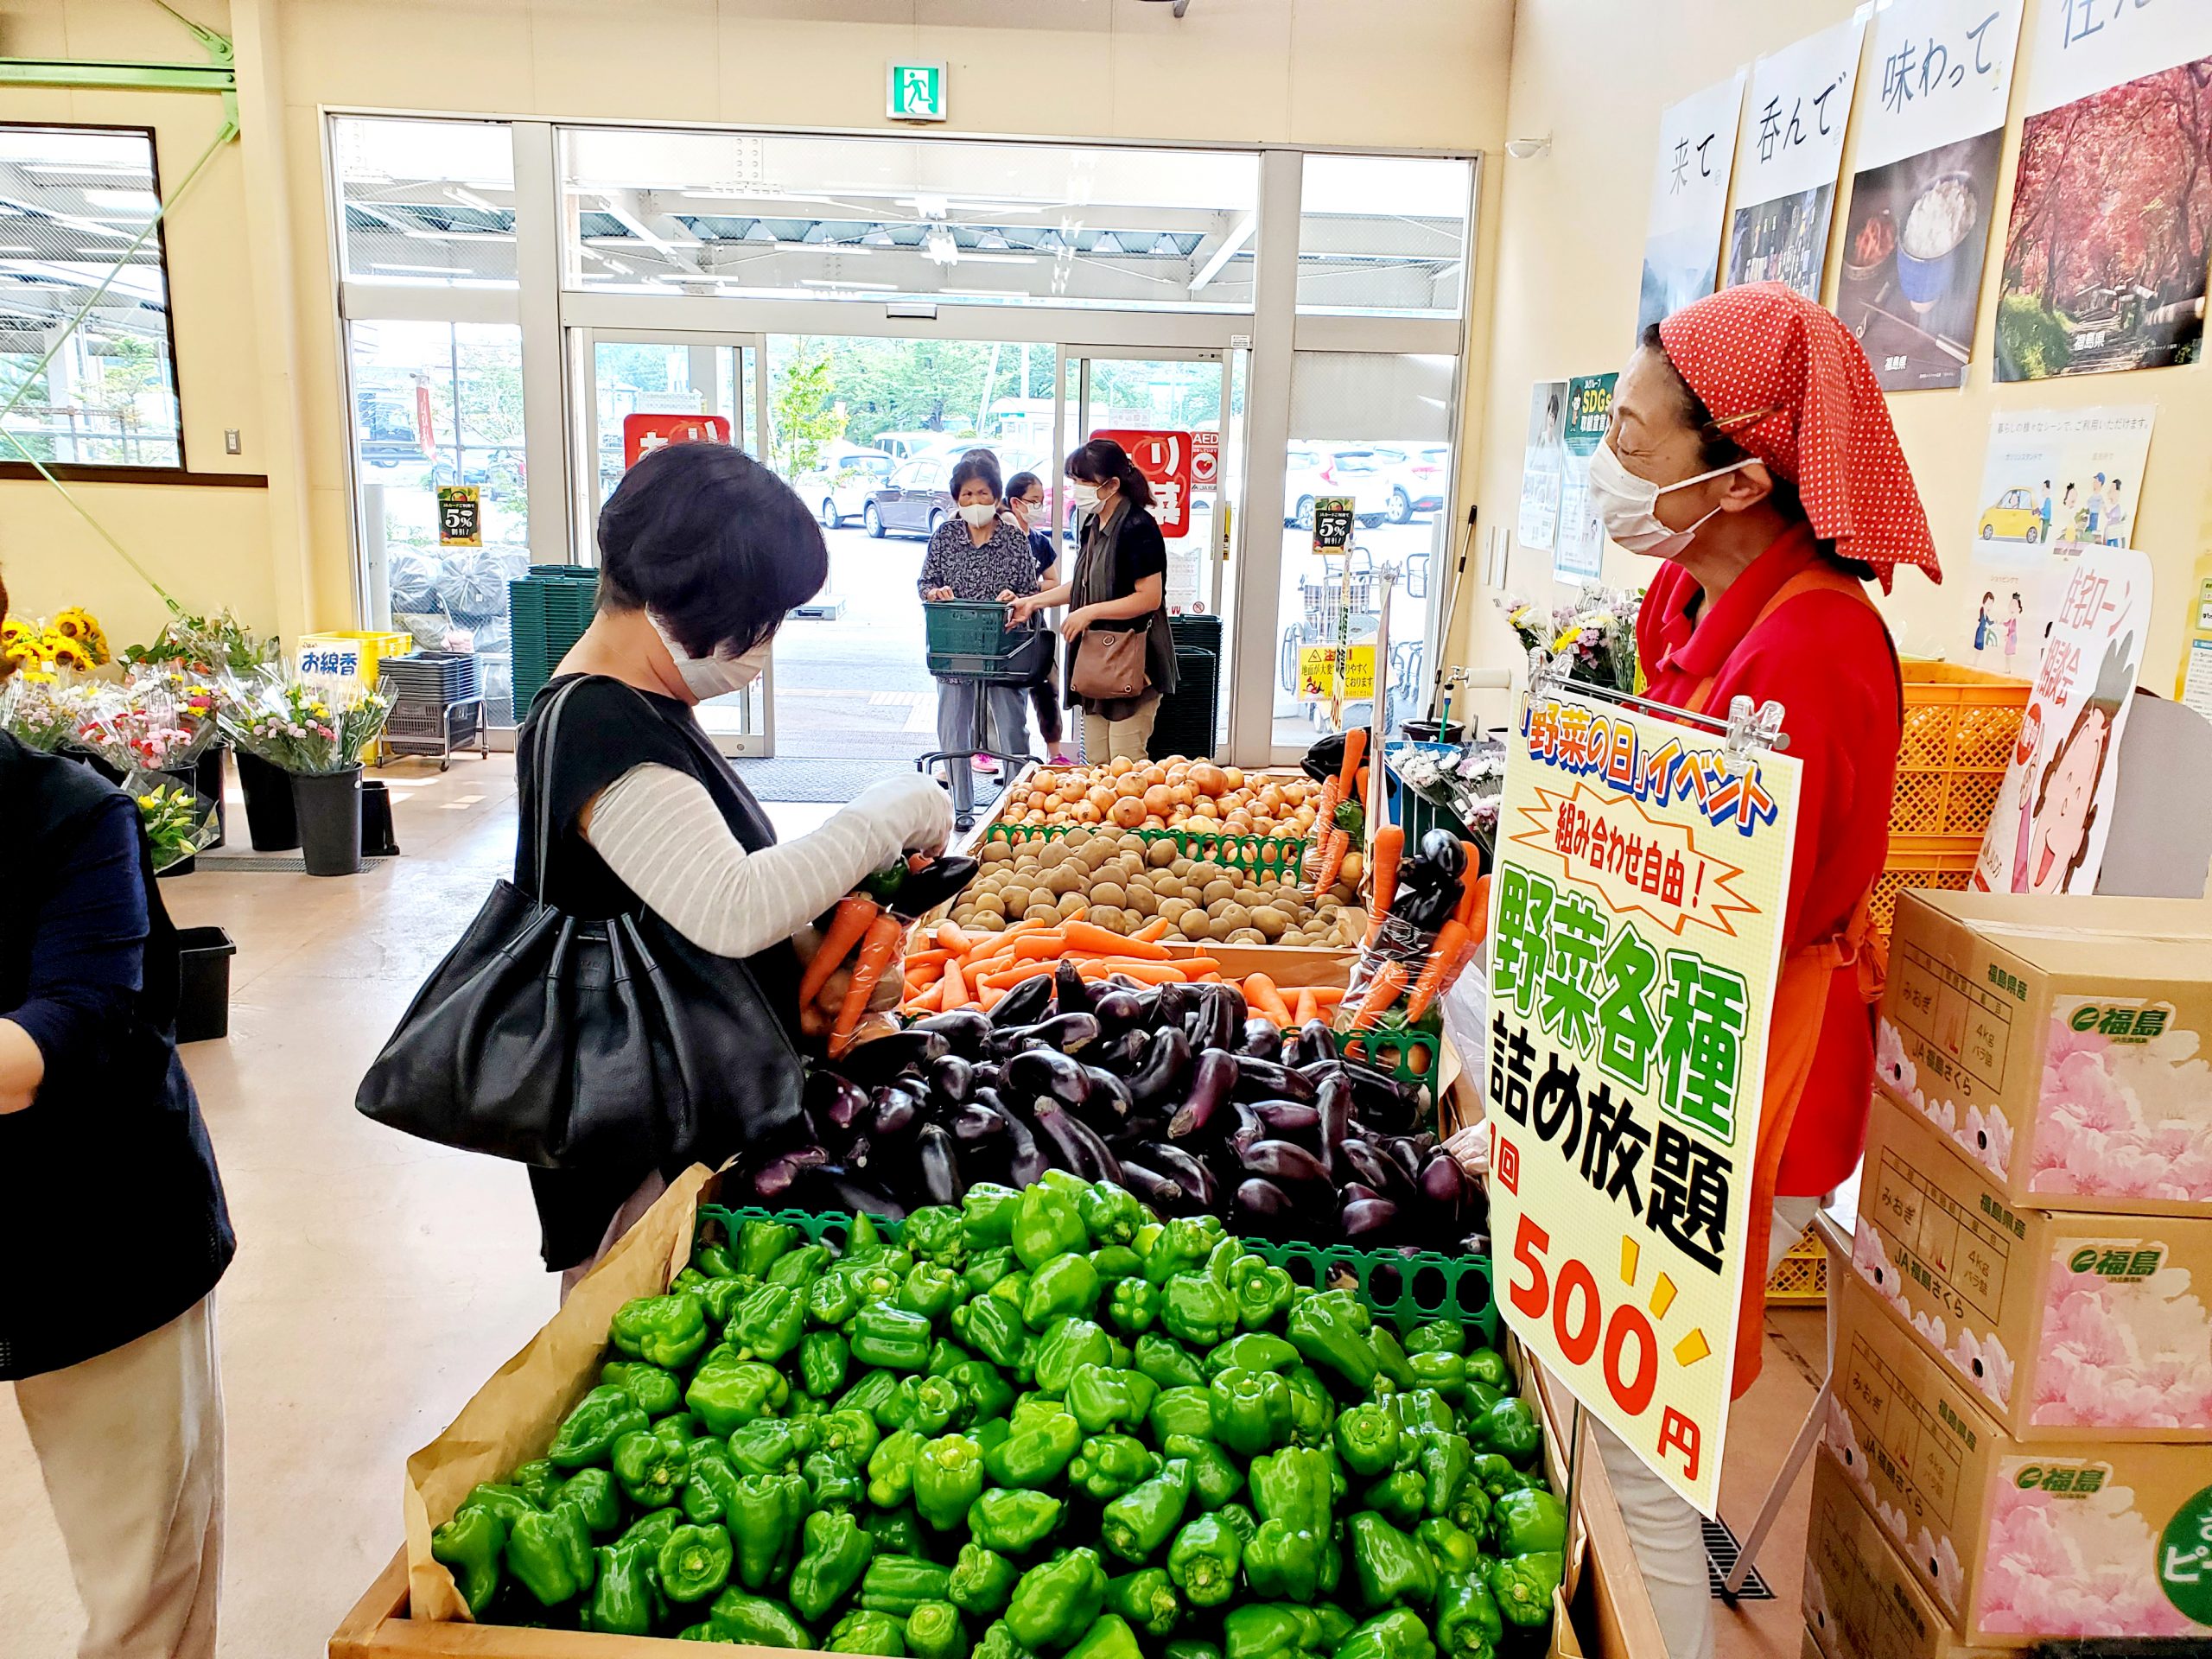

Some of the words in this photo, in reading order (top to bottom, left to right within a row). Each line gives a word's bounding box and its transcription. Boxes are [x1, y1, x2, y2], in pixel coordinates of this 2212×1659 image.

[1881, 11, 2000, 114] 味わって
[1757, 72, 1847, 164] 呑んで
[1669, 133, 1716, 195] 来て
[1885, 356, 1908, 372] 福島県
[2074, 332, 2105, 351] 福島県
[1193, 434, 1218, 444] AED
[445, 509, 473, 528] 5%
[1319, 518, 1345, 537] 5%
[2058, 566, 2133, 638] 住宅ローン
[302, 652, 358, 676] お線香
[2037, 636, 2082, 710] 相談会
[1519, 693, 1777, 835] 「野菜の日」イベント
[1555, 802, 1707, 909] 組み合わせ自由！
[1491, 861, 1750, 1147] 野菜各種
[1987, 962, 2028, 1002] 福島県産
[1976, 1024, 1994, 1048] 4kg
[2098, 1007, 2169, 1037] 福島
[1912, 1039, 1972, 1096] JA福島さくら
[1490, 1010, 1733, 1276] 詰め放題
[1490, 1121, 1520, 1198] 1回
[1980, 1192, 2026, 1240] 福島県産
[1894, 1248, 1964, 1319] JA福島さくら
[1967, 1250, 1990, 1277] 4kg
[2095, 1249, 2162, 1276] 福島
[2042, 1467, 2106, 1493] 福島
